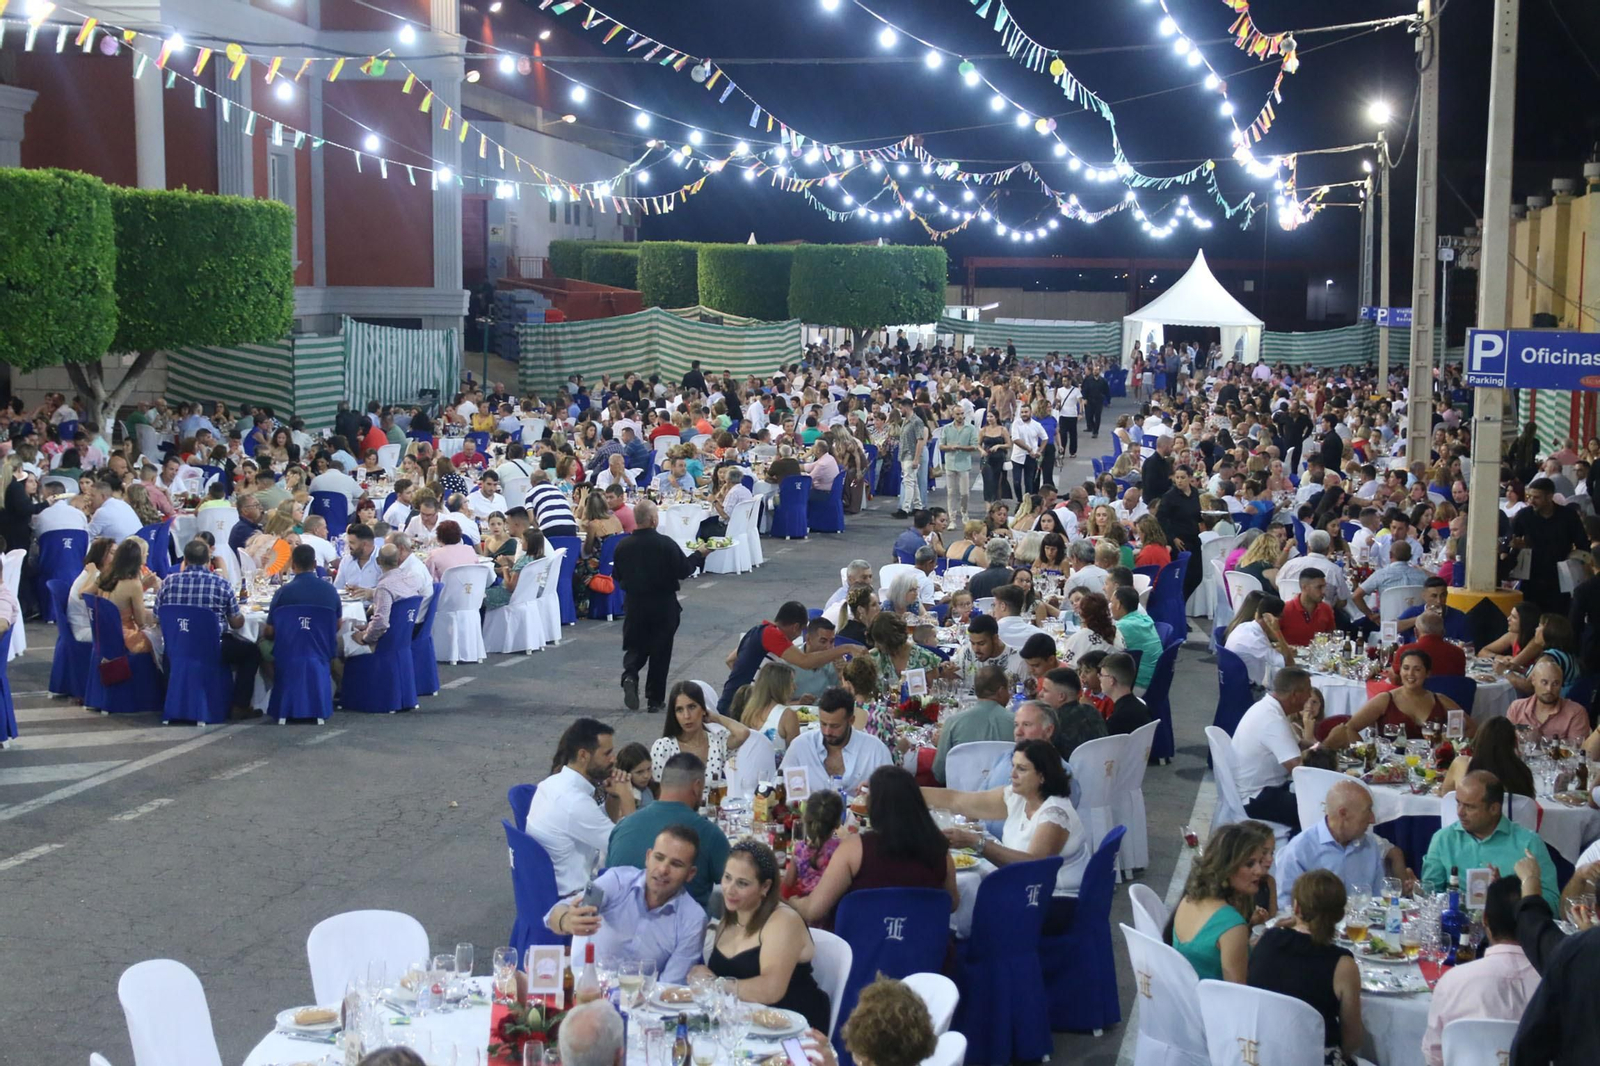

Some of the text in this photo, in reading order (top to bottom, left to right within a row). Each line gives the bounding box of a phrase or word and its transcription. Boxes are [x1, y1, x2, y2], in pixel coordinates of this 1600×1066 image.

[1360, 307, 1368, 316] P
[1377, 308, 1388, 322] P
[1472, 334, 1504, 371] P
[1521, 347, 1600, 366] Oficinas
[1469, 376, 1504, 387] Parking
